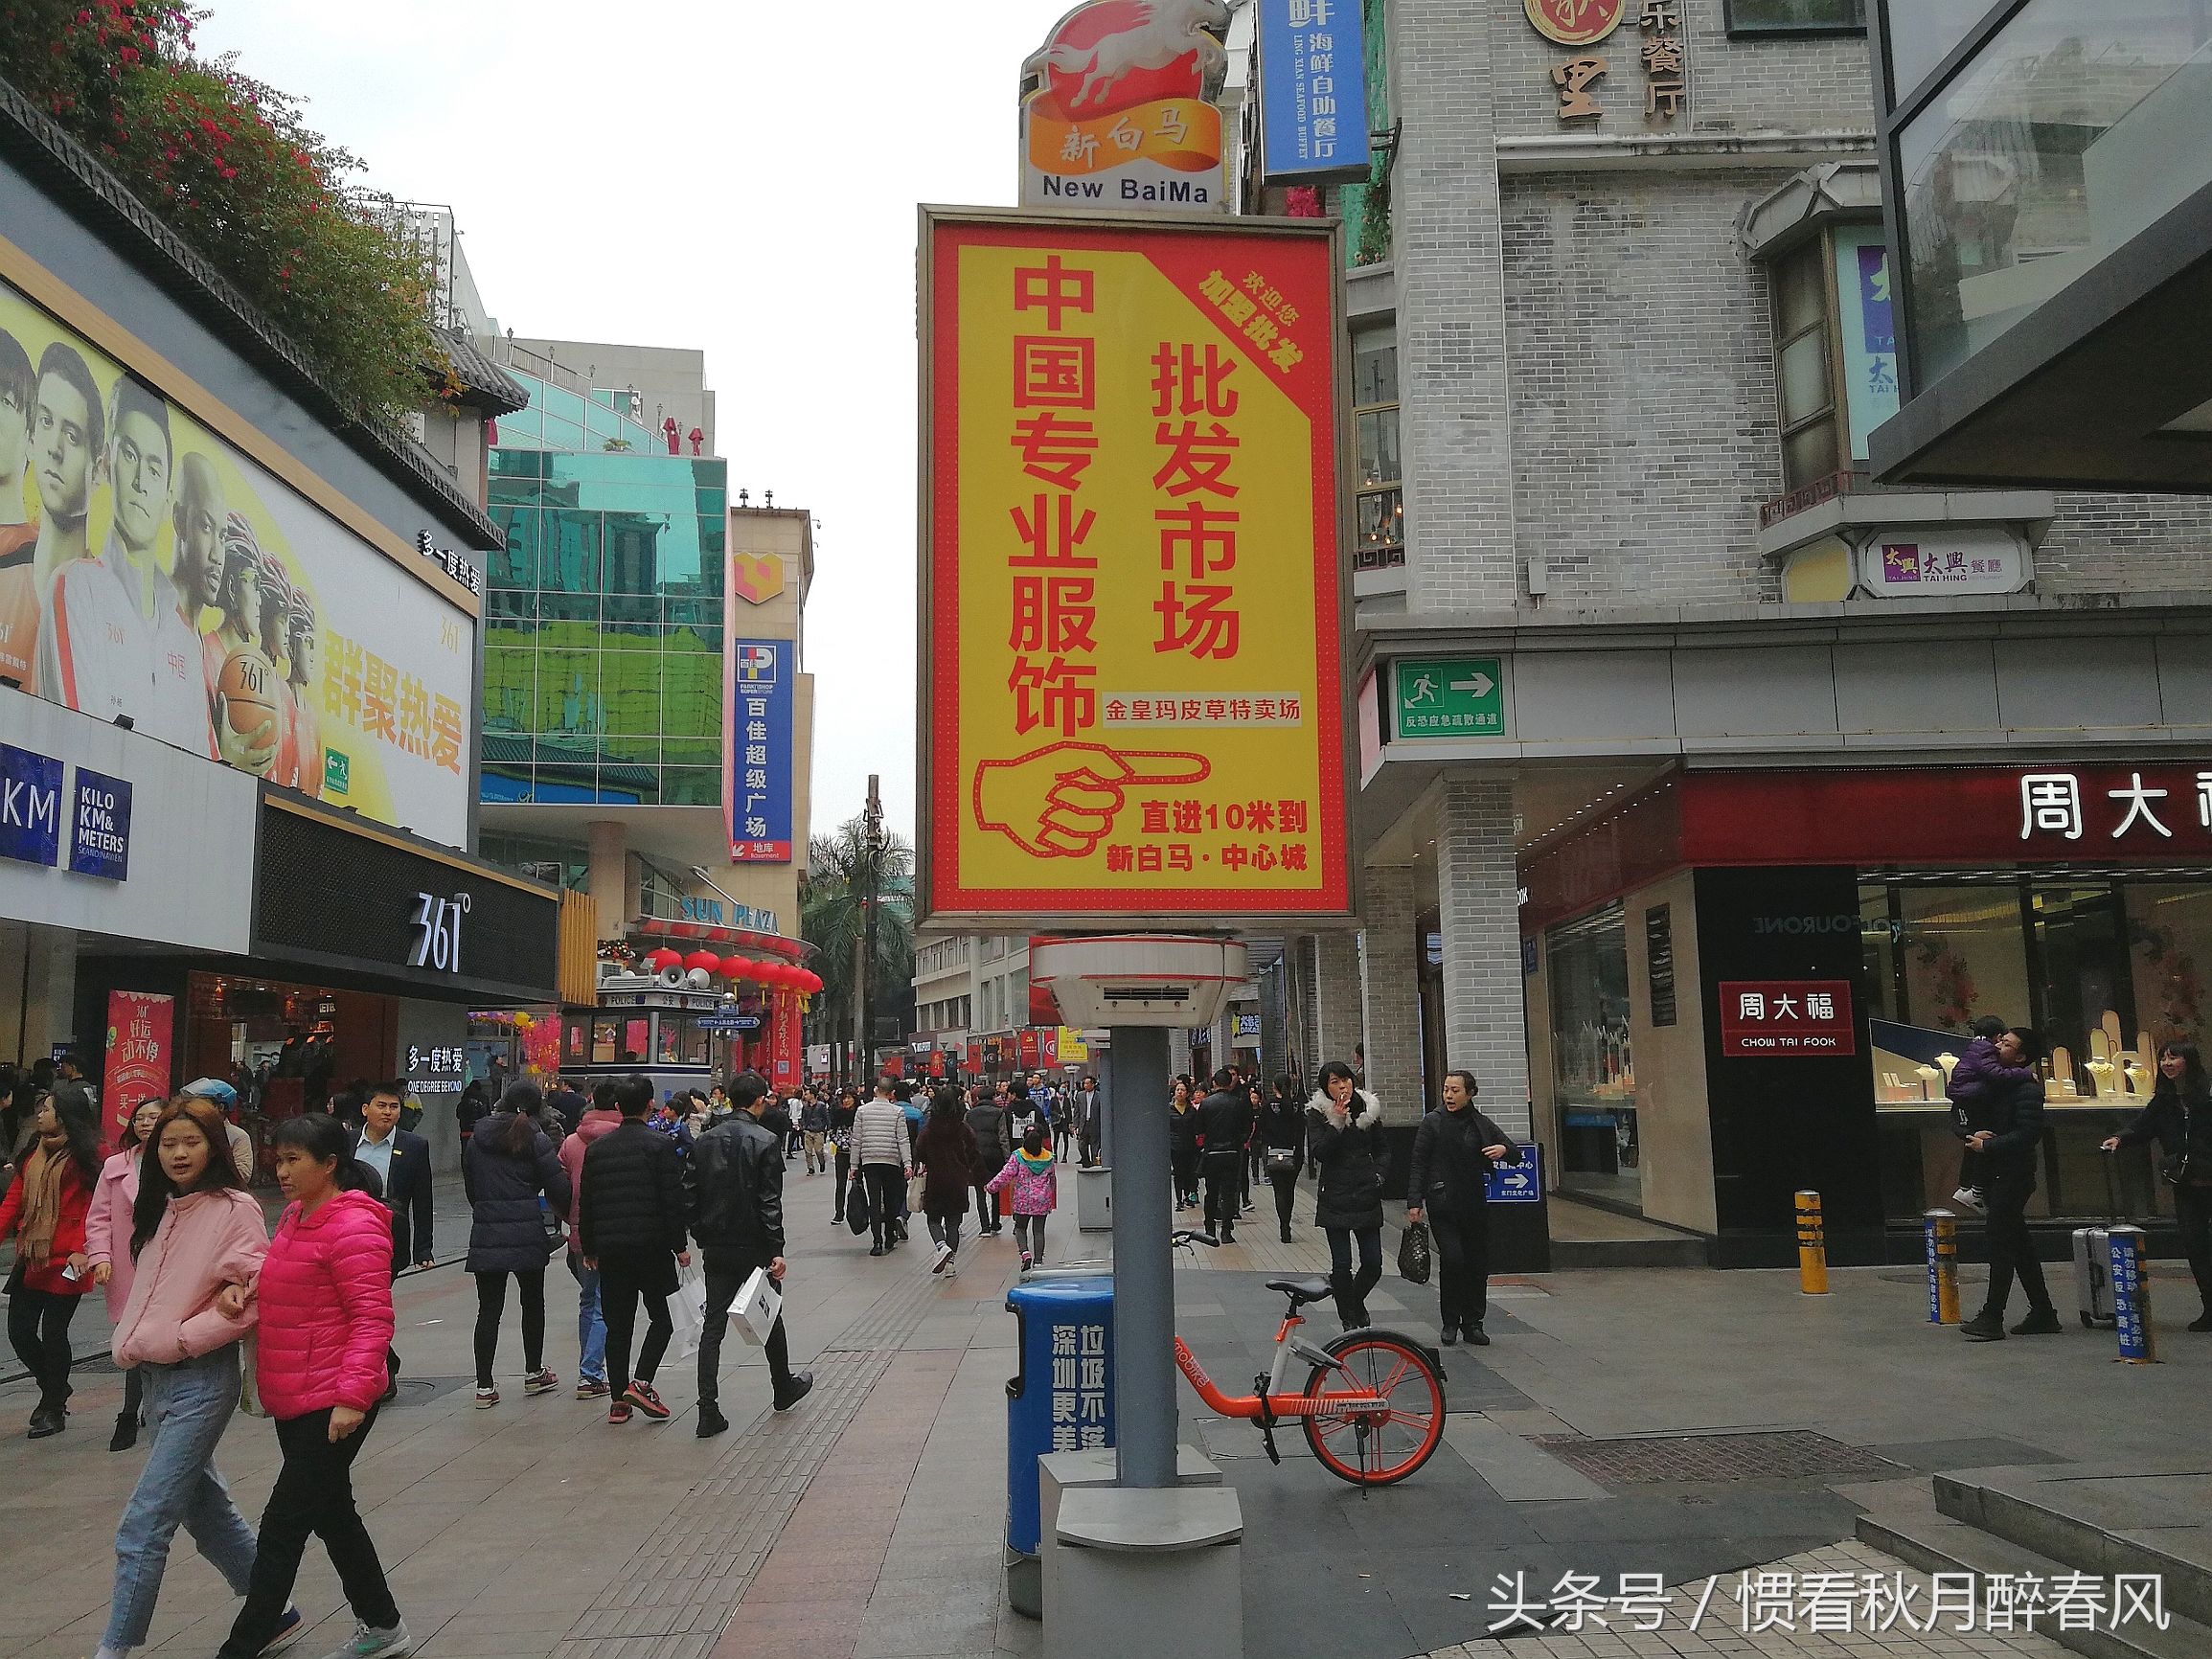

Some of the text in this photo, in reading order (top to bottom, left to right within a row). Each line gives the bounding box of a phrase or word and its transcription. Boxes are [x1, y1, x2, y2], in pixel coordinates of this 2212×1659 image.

[1296, 82, 1307, 123] SEAFOOD
[1310, 33, 1338, 158] 海鲜自助餐厅
[1060, 107, 1188, 170] 新白马
[1297, 126, 1309, 160] BUFFET
[1043, 175, 1209, 203] New BaiMa
[1243, 270, 1301, 327] 欢迎您
[1198, 268, 1304, 374] 加盟批发
[1008, 255, 1099, 738] 中国专业服饰
[1151, 342, 1241, 661] 批发市场
[422, 529, 481, 597] 多一度热爱
[1943, 574, 1968, 582] HING
[323, 628, 463, 776] 群聚热爱
[1106, 698, 1301, 721] 金皇玛皮草特卖场
[1406, 713, 1497, 728] 反恐应急疏散通道
[745, 697, 767, 838] 百佳超级广场
[81, 785, 114, 810] KILO
[80, 805, 114, 831] KM&
[1141, 799, 1309, 834] 直进10米到
[78, 827, 125, 853] METERS
[681, 896, 780, 935] SUN PLAZA
[418, 892, 471, 973] 361°
[611, 996, 636, 1005] POLICE
[692, 998, 714, 1009] POLICE
[1740, 992, 1835, 1020] 周大福
[129, 1019, 152, 1038] 好运
[1742, 1037, 1836, 1047] CHOW TAI FOOK
[121, 1038, 160, 1063] 动不停
[407, 1044, 463, 1073] 多一度热爱
[407, 1079, 463, 1093] ONE DEGREE BEYOND
